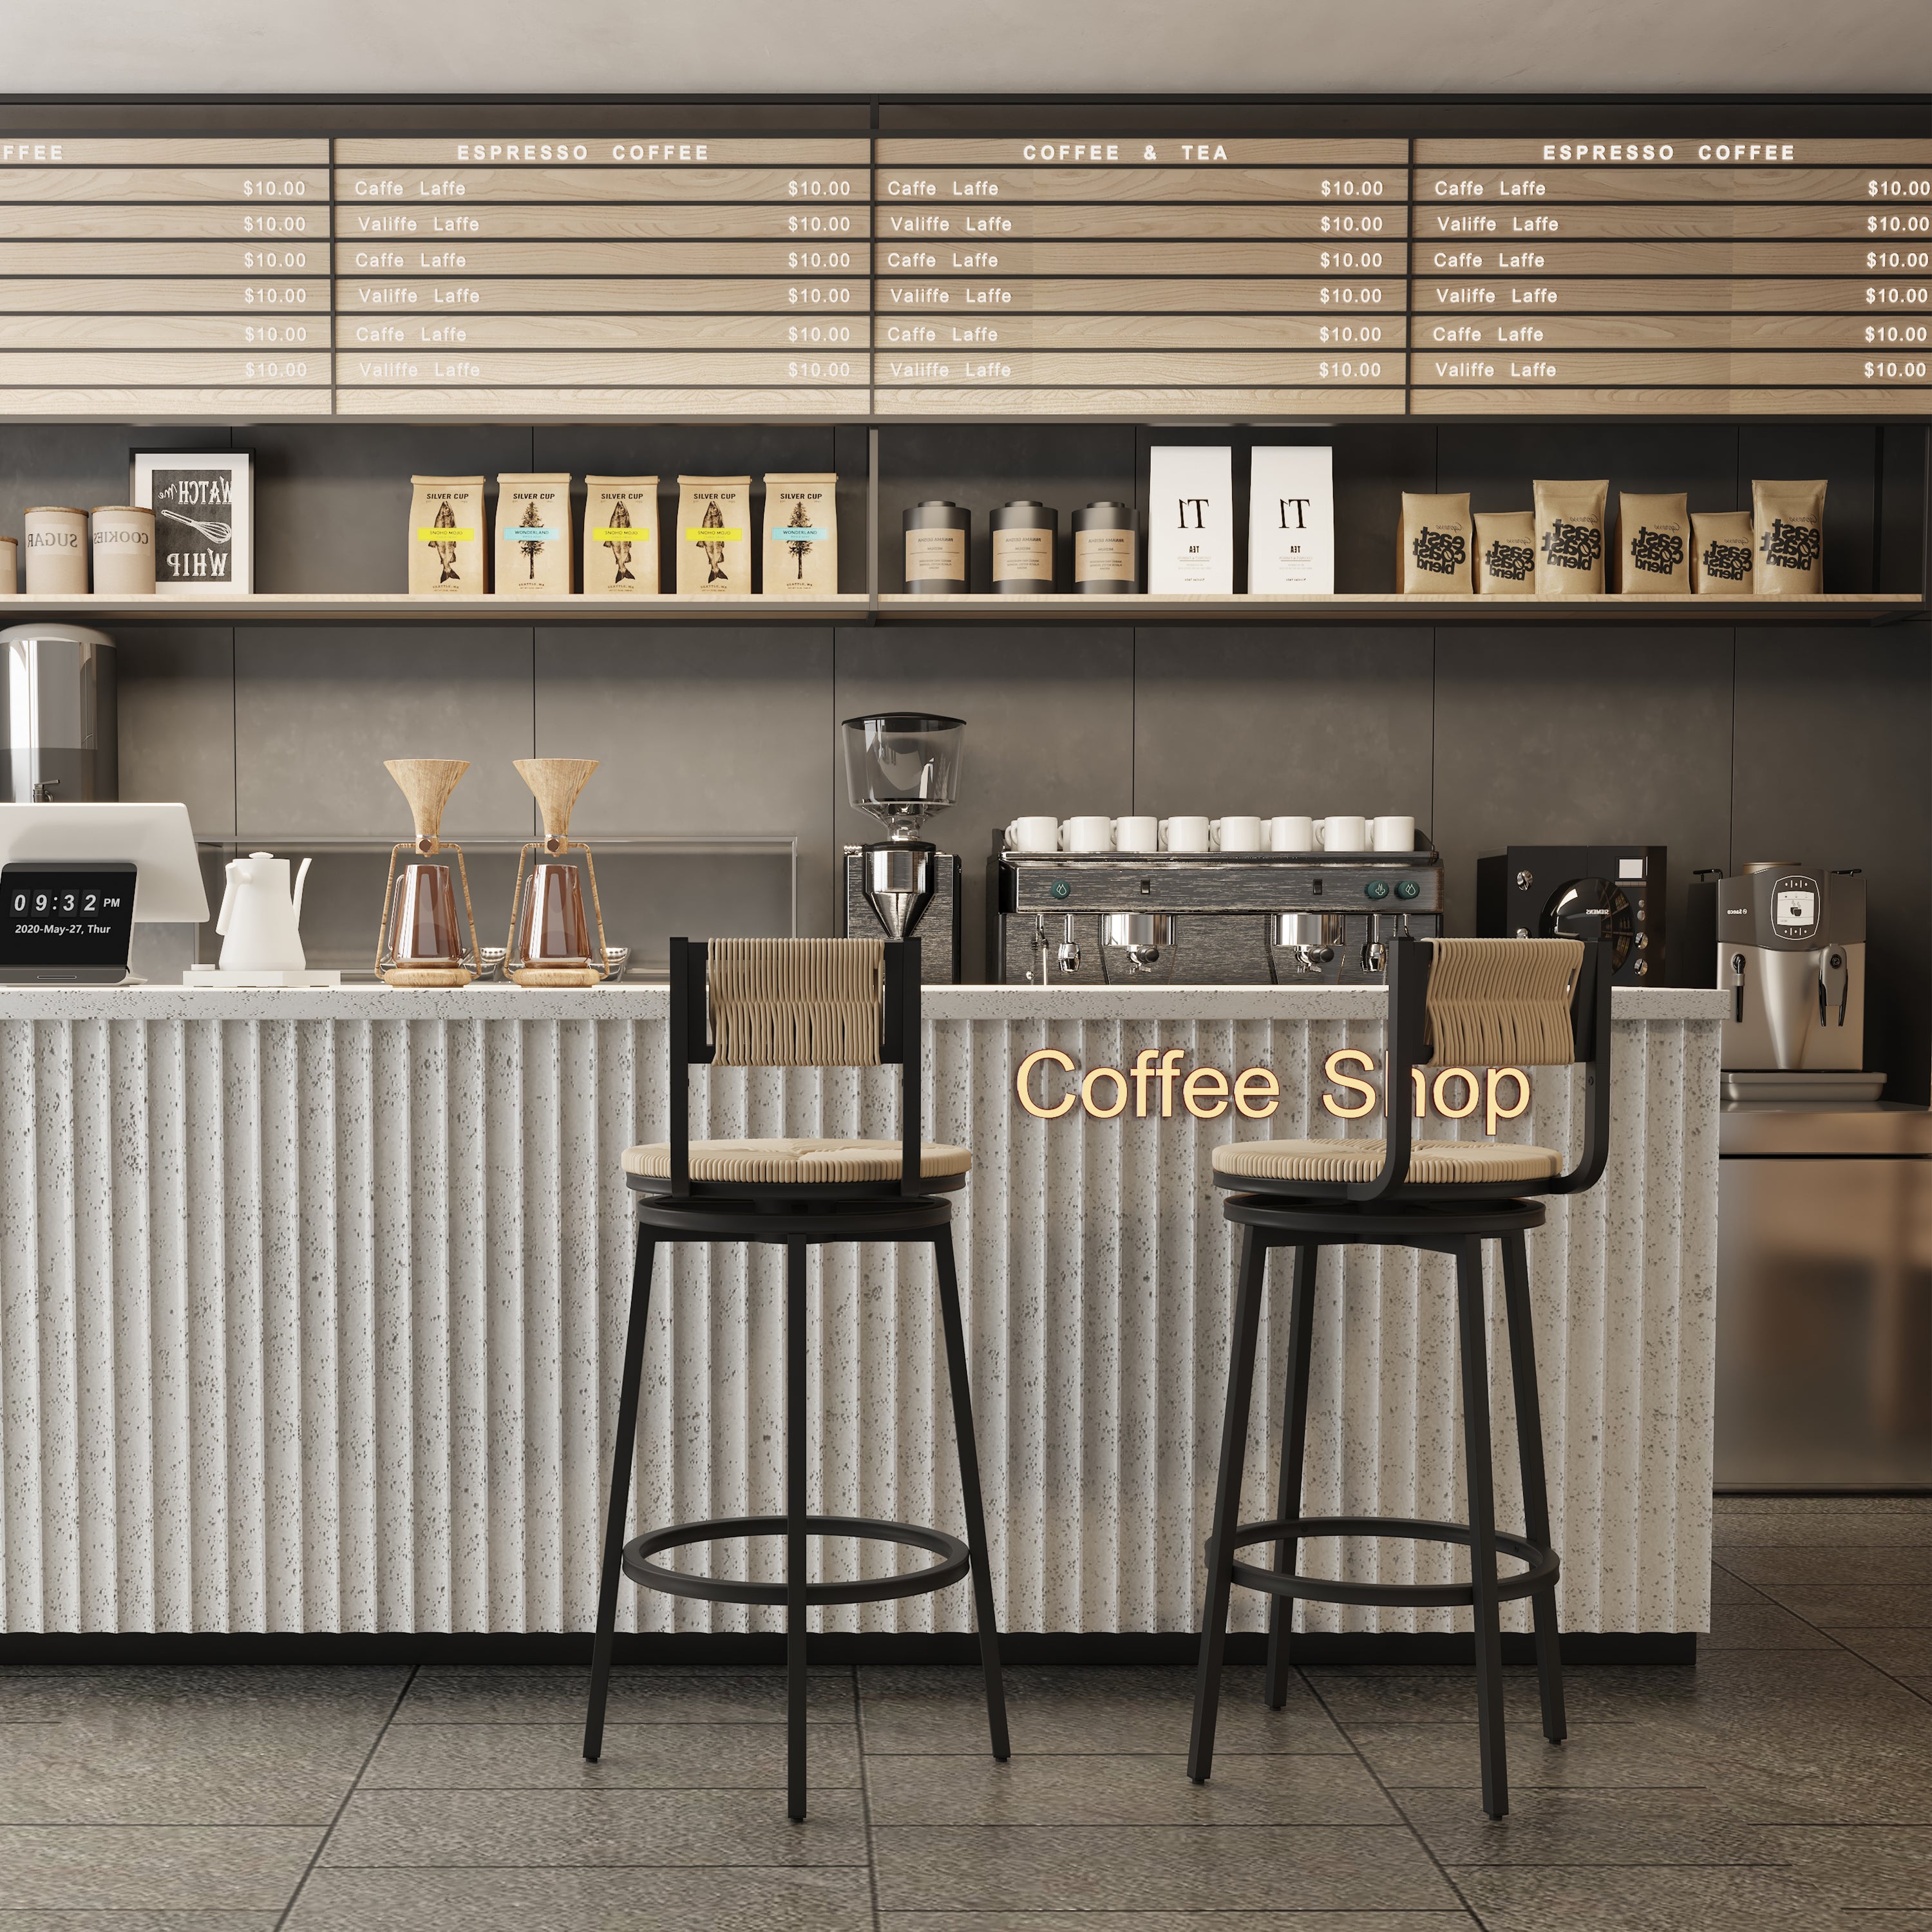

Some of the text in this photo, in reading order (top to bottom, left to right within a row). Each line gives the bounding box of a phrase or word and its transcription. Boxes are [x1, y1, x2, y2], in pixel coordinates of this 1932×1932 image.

[457, 144, 707, 160] ESPRESSO COFFEE
[1023, 144, 1227, 160] COFFEE & TEA
[1544, 144, 1794, 160] ESPRESSO COFFEE
[243, 180, 305, 196] $10.00
[355, 180, 850, 197] Caffe Laffe $10.00
[887, 180, 1383, 197] Caffe Laffe $10.00
[1435, 180, 1931, 197] Caffe Laffe $10.00
[244, 216, 306, 232] $10.00
[358, 215, 850, 232] Valiffe Laffe $10.00
[891, 216, 1383, 232] Valiffe Laffe $10.00
[1437, 216, 1929, 232] Valiffe Laffe $10.00
[244, 252, 306, 269] $10.00
[355, 252, 850, 269] Caffe Laffe $10.00
[887, 252, 1382, 269] Caffe Laffe $10.00
[1434, 251, 1929, 269] Caffe Laffe $10.00
[245, 287, 306, 305] $10.00
[359, 287, 850, 305] Valiffe Laffe $10.00
[890, 287, 1381, 305] Valiffe Laffe $10.00
[1436, 287, 1928, 305] Valiffe Laffe $10.00
[245, 326, 307, 343] $10.00
[356, 326, 850, 343] Caffe Laffe $10.00
[887, 326, 1381, 343] Caffe Laffe $10.00
[1433, 326, 1927, 343] Caffe Laffe $10.00
[245, 361, 307, 378] $10.00
[360, 361, 849, 378] Valiffe Laffe $10.00
[890, 361, 1381, 378] Valiffe Laffe $10.00
[1435, 361, 1926, 378] Valiffe Laffe $10.00
[14, 894, 120, 911] 09:32 PM
[15, 924, 111, 936] 2020-May-27, Thur
[1016, 1048, 1280, 1119] Coffee
